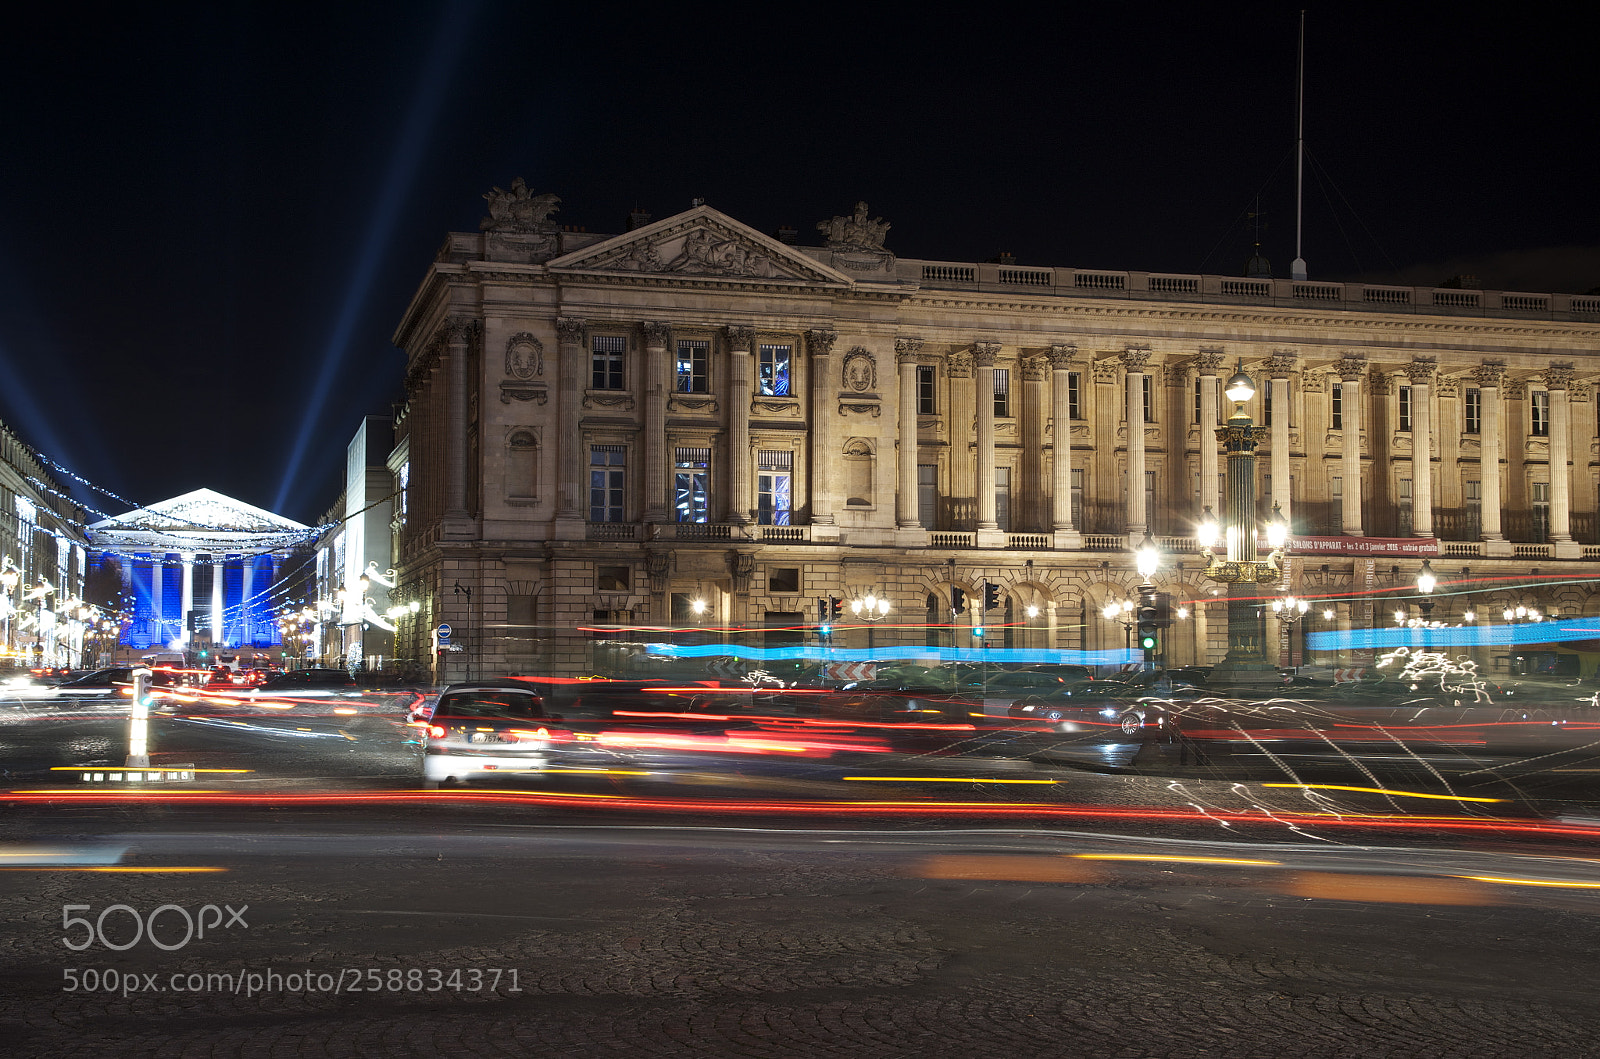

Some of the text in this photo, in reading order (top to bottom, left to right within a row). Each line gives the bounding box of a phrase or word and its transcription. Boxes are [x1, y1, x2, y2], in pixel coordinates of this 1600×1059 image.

[1292, 540, 1313, 549] SALONS
[1313, 541, 1342, 550] D'APPARAT
[1369, 542, 1386, 552] janvier
